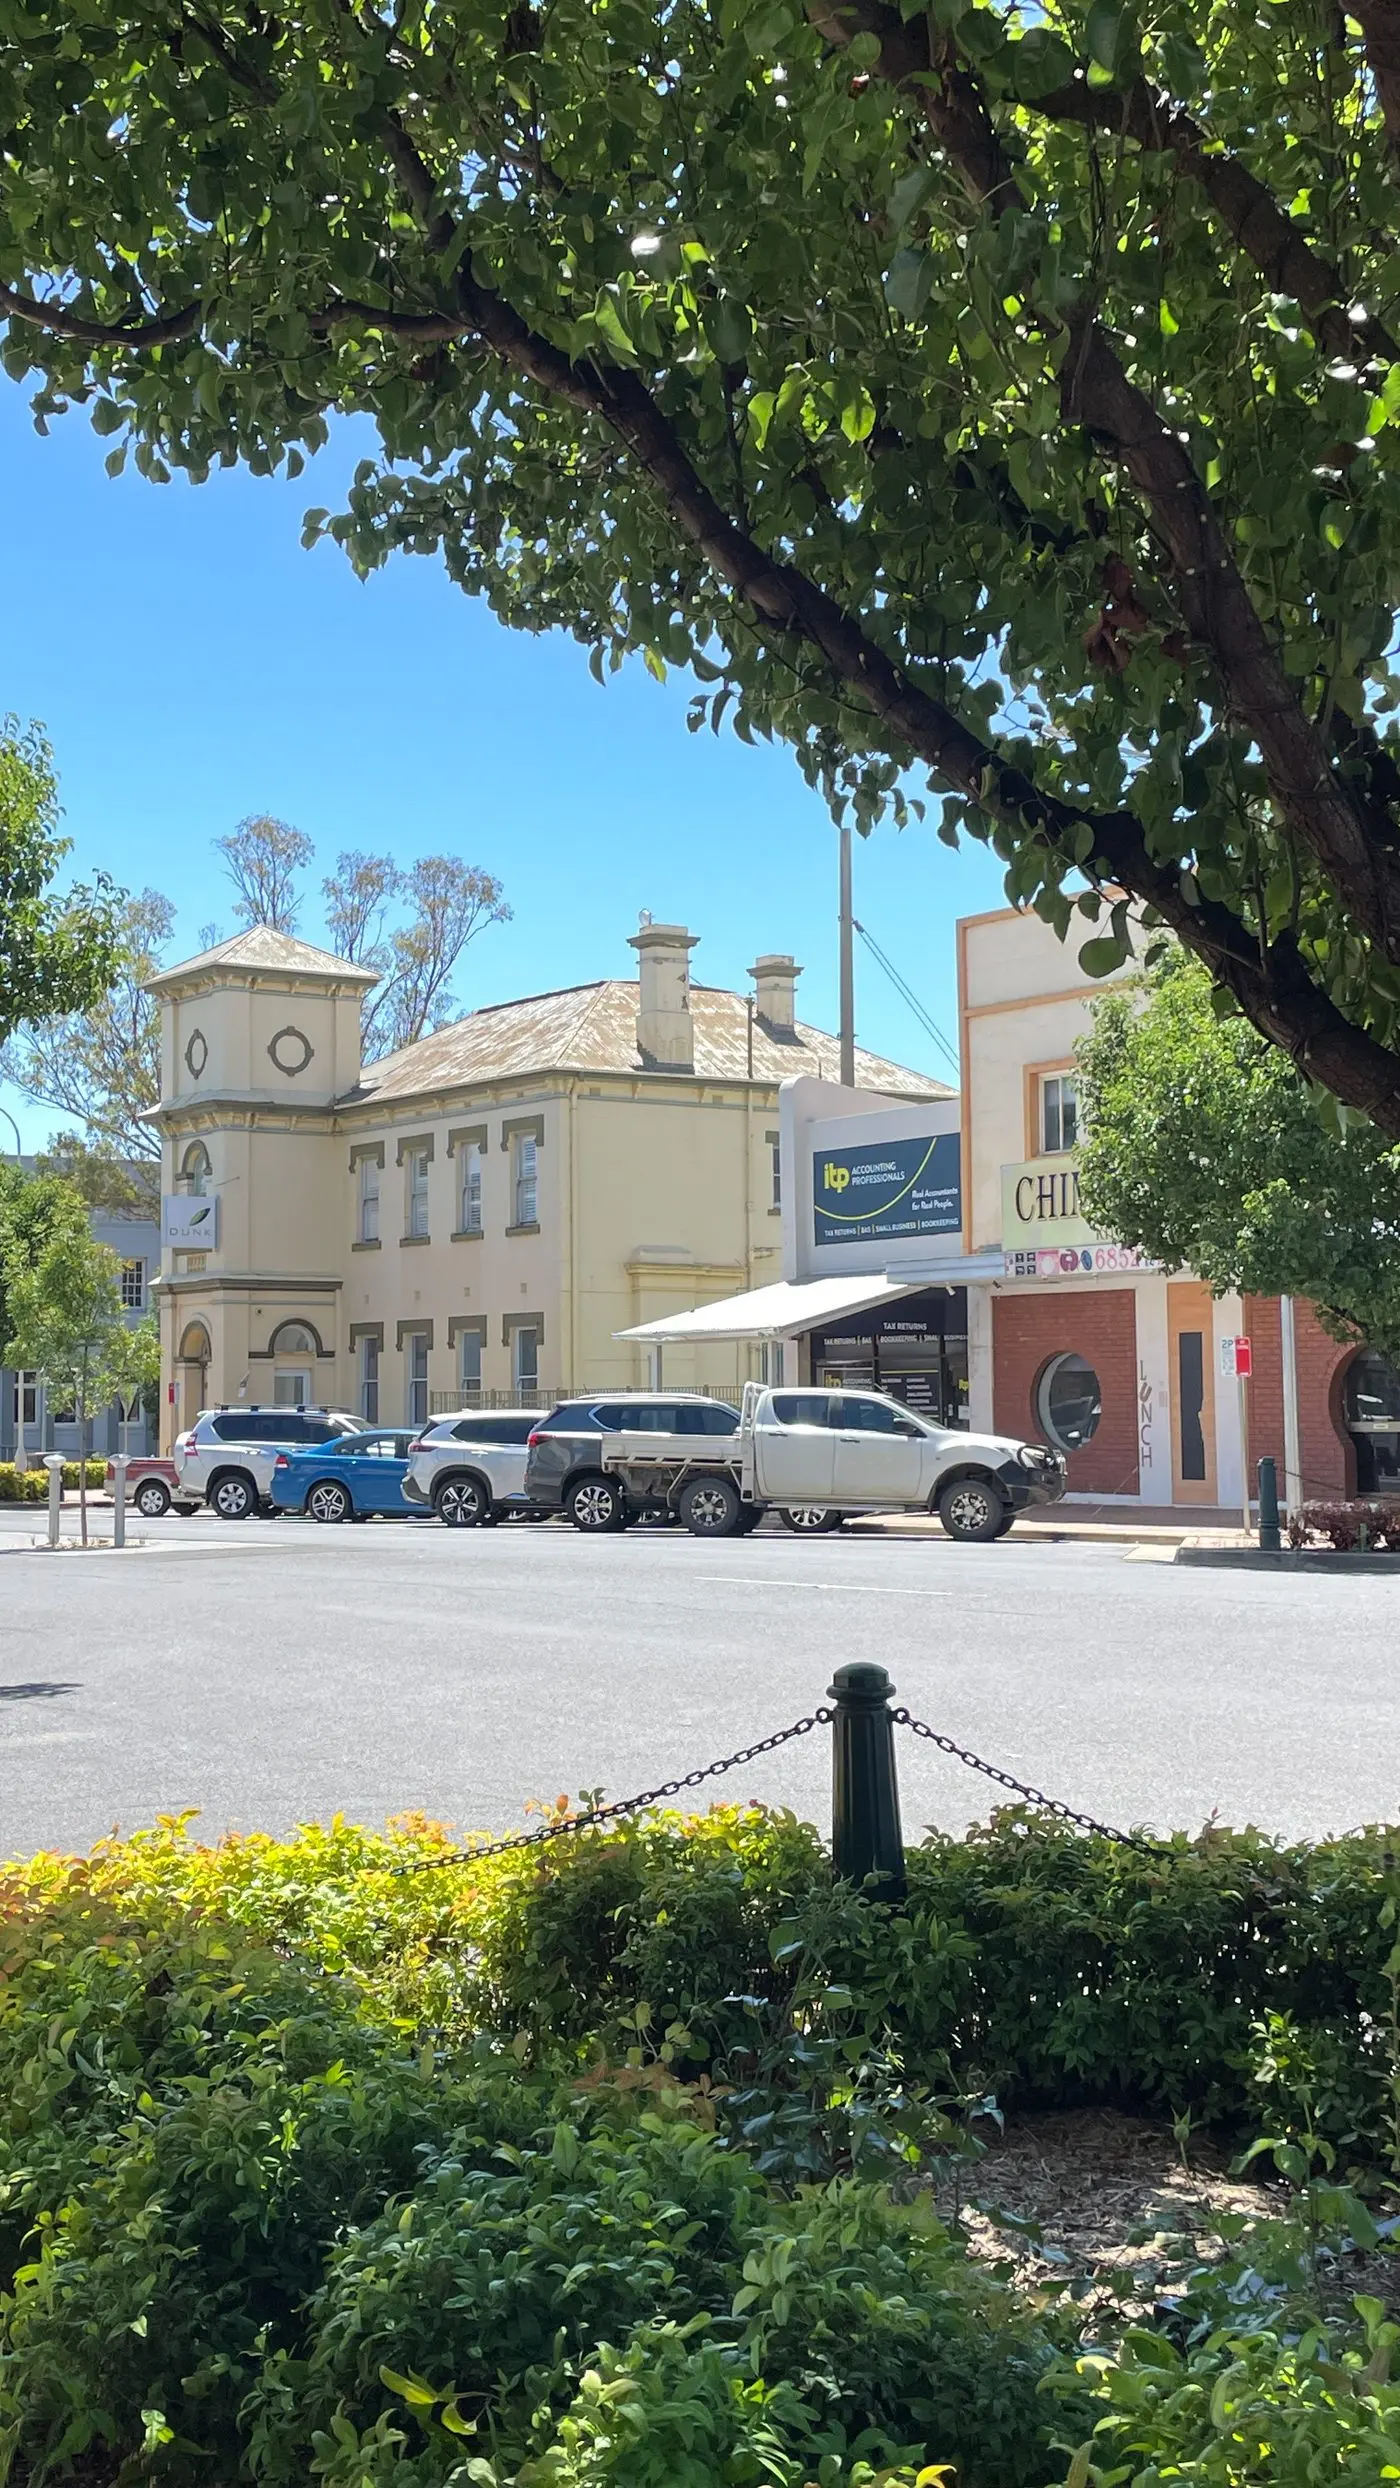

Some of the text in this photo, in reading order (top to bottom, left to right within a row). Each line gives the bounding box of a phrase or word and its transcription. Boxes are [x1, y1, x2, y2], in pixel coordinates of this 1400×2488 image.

[851, 1161, 897, 1175] ACCOUNTING
[824, 1162, 850, 1193] itp
[851, 1170, 906, 1186] PROFESSIONALS
[169, 1227, 213, 1236] DUNK
[883, 1322, 927, 1331] TAX RETURNS
[1221, 1339, 1234, 1349] 2P
[1140, 1360, 1152, 1468] LUNCH
